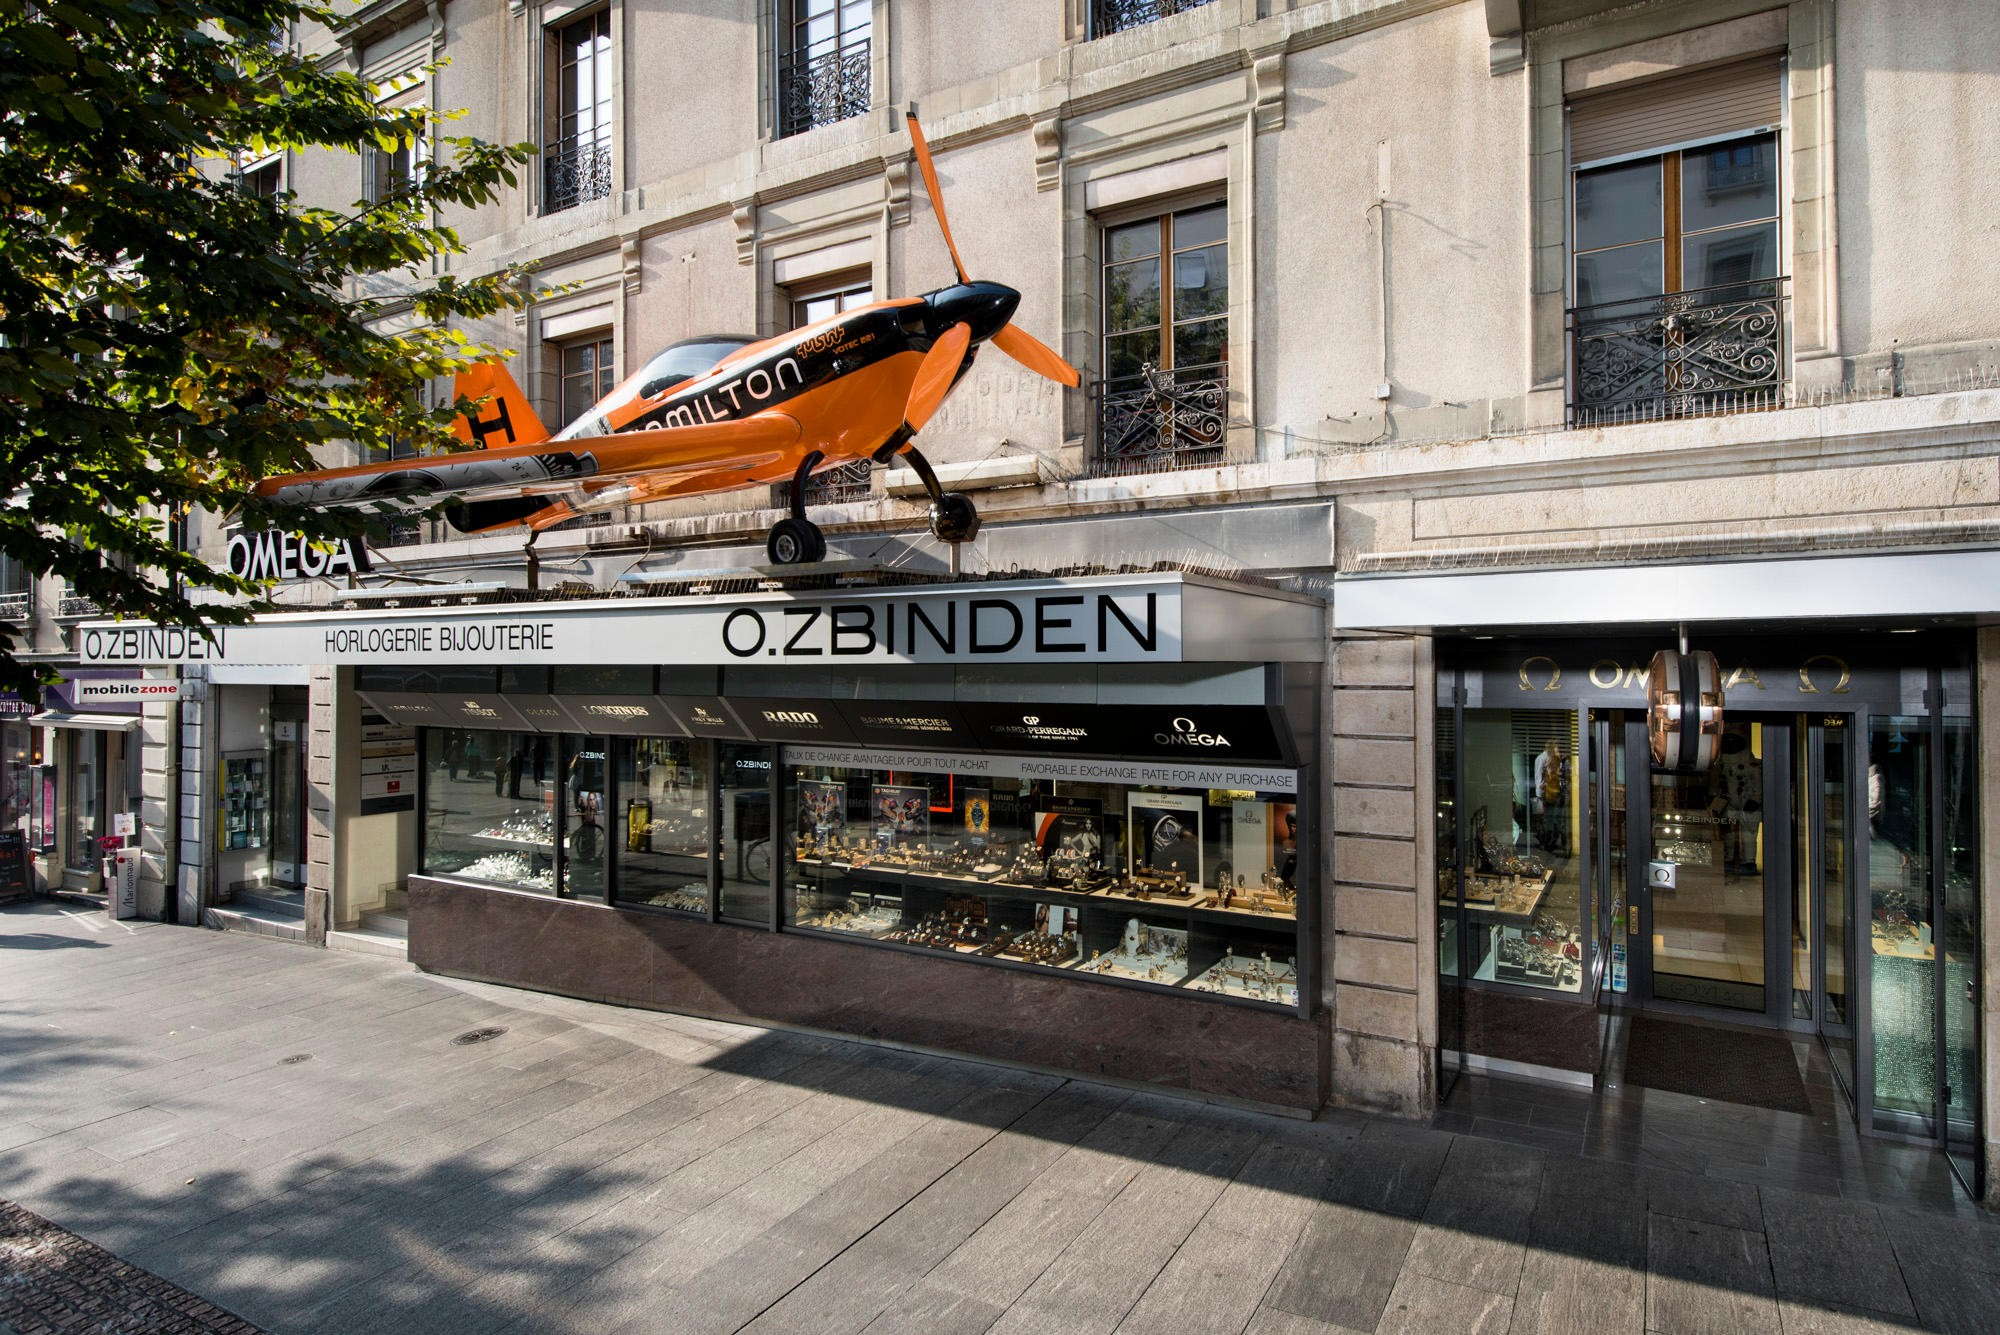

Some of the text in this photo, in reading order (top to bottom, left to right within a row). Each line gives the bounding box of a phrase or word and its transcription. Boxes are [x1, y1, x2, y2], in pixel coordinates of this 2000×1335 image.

[832, 340, 860, 355] VOTEC
[467, 396, 516, 449] H
[226, 529, 357, 581] OMEGA
[722, 593, 1157, 657] O.ZBINDEN
[86, 627, 225, 660] O.ZBINDEN
[325, 624, 553, 652] HORLOGERIE BIJOUTERIE
[83, 685, 177, 695] mobilezone
[581, 705, 649, 717] LONGINES
[761, 711, 819, 724] RADO
[1022, 716, 1040, 726] GP
[1153, 733, 1232, 747] OMEGA
[785, 752, 989, 770] TAUX DE CHANGE AVANTAGEUX POUR TOUT ACHAT
[1021, 762, 1293, 787] FAVORABLE EXCHANGE RATE FOR ANY PURCHASE
